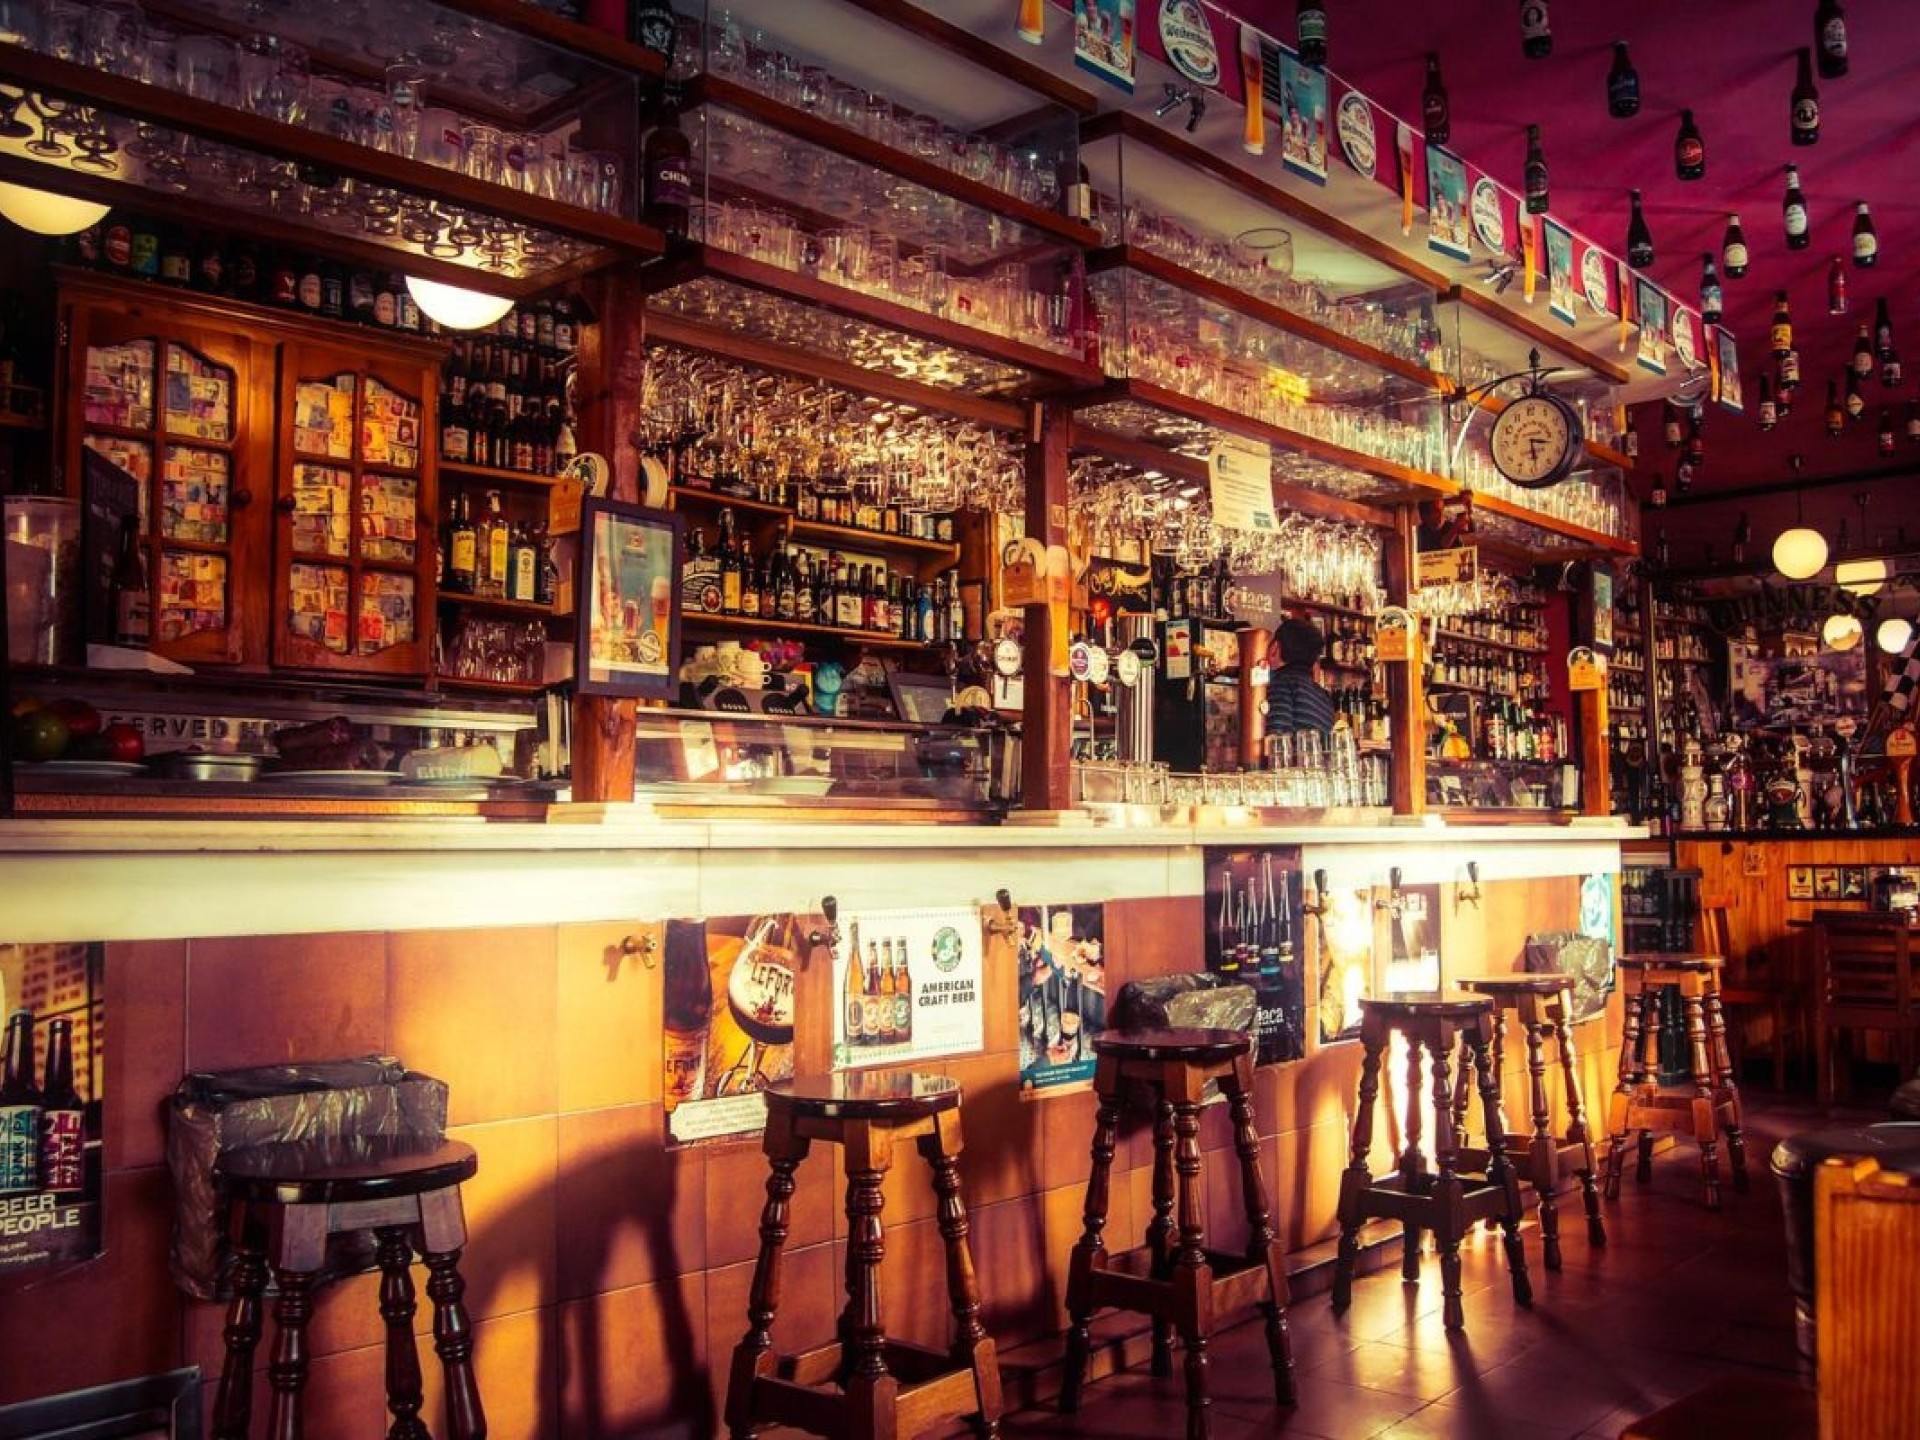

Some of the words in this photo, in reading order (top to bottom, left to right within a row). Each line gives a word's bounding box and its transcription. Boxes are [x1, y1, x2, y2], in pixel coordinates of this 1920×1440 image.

[921, 979, 974, 994] AMERICAN
[918, 994, 949, 1007] CRAFT
[952, 991, 975, 1004] BEER
[0, 1208, 81, 1237] EOPLE
